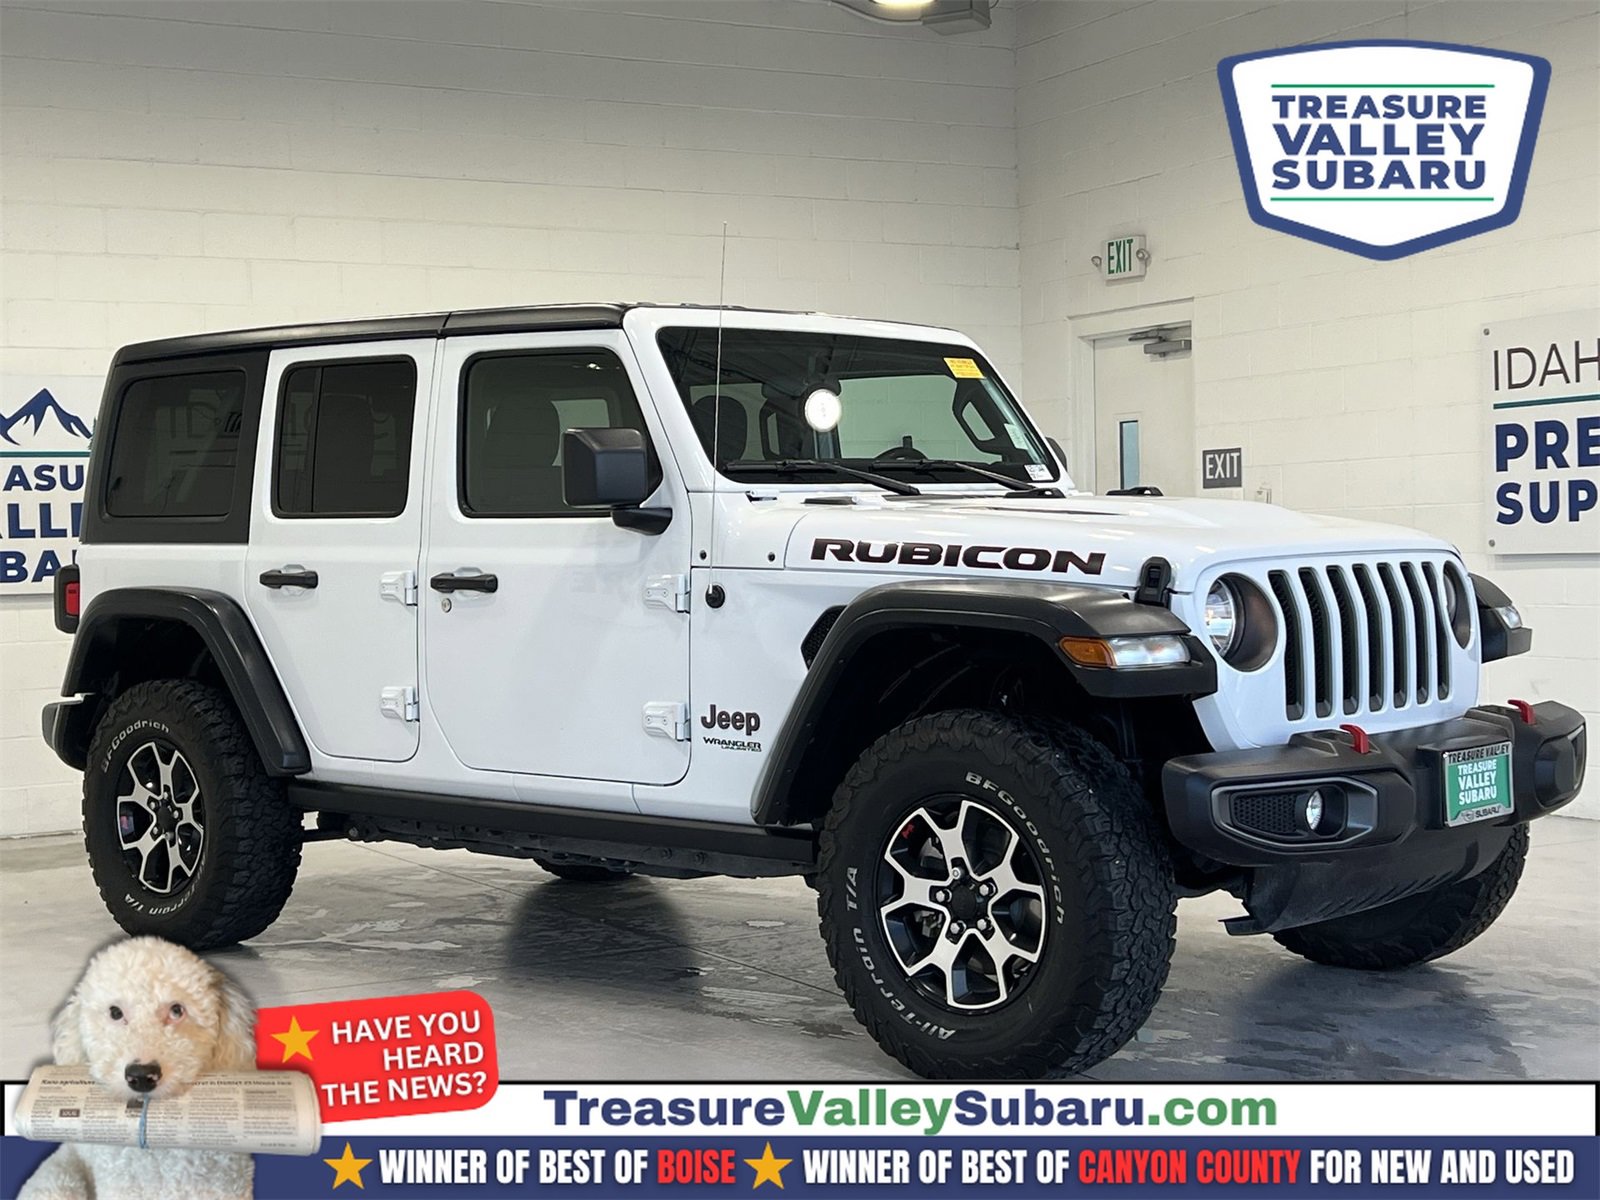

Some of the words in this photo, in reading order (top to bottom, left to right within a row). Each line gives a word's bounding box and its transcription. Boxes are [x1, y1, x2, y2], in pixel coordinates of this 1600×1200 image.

[1107, 238, 1133, 275] EXIT
[1205, 451, 1241, 480] EXIT
[810, 538, 1107, 575] RUBICON
[700, 703, 761, 736] Jeep
[101, 719, 169, 774] BFGoodrich
[703, 736, 761, 749] WRANGLER
[1448, 749, 1485, 764] TREASURE
[1486, 743, 1510, 758] VALLEY
[1457, 759, 1497, 776] TREASURE
[1458, 770, 1497, 791] VALLEY
[1458, 785, 1497, 805] SUBARU
[1475, 805, 1501, 818] SUBARU
[965, 772, 1064, 925] BFGoodrich
